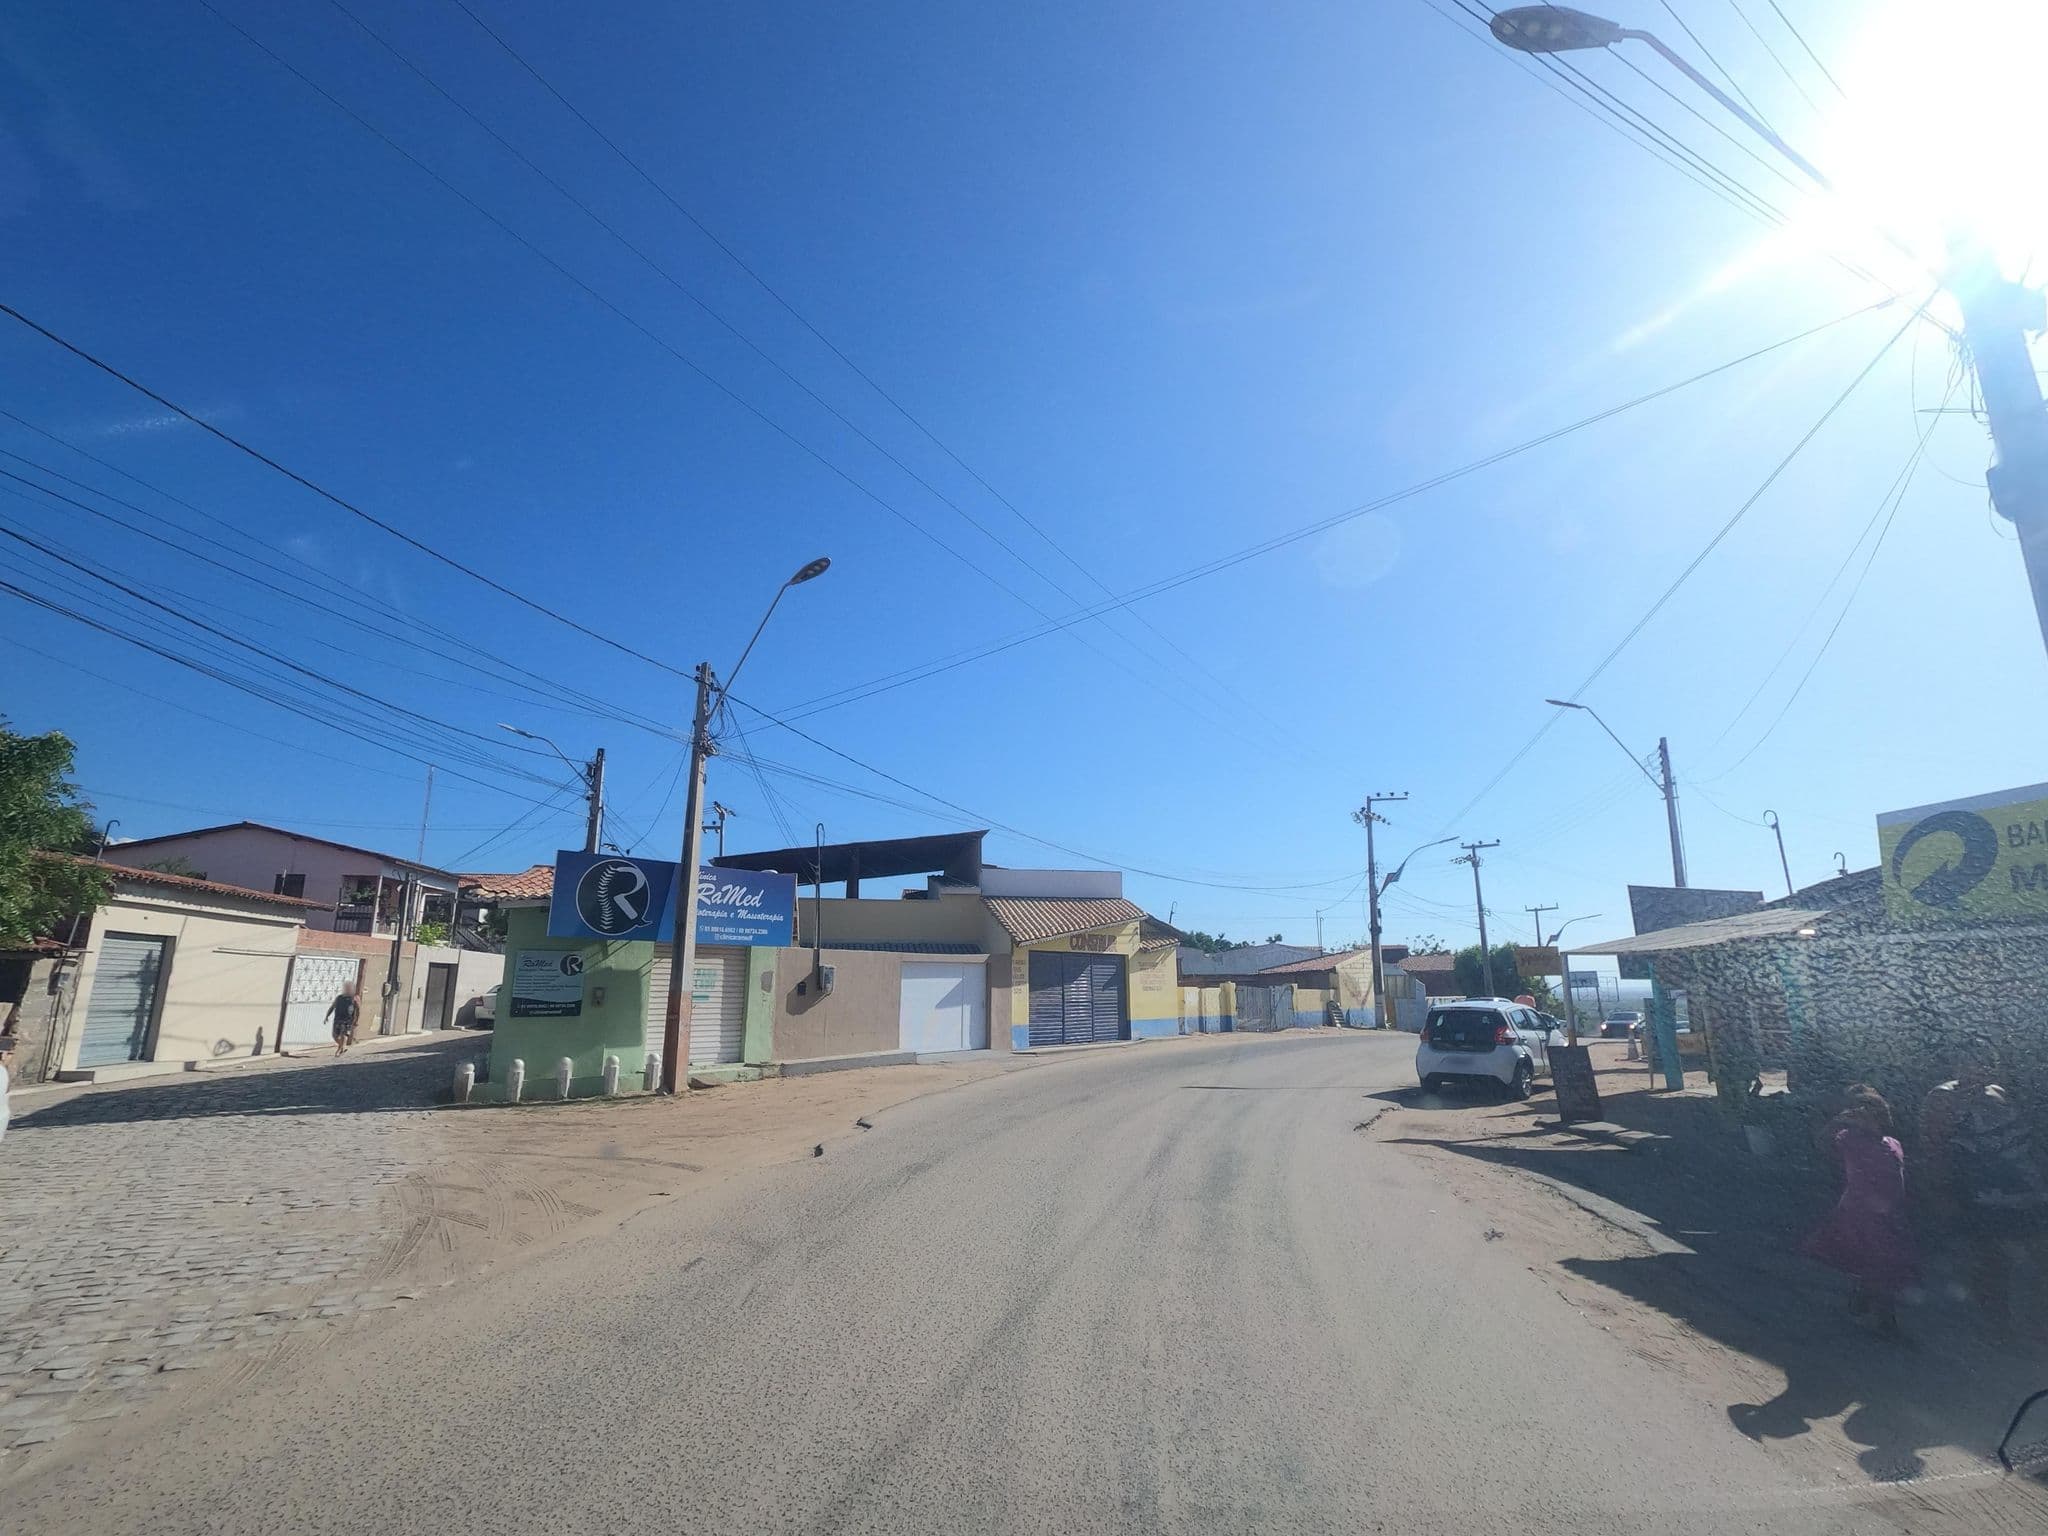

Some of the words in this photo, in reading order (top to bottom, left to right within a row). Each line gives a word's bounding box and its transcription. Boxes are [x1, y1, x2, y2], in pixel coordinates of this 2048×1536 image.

[2007, 820, 2048, 848] BA
[697, 882, 764, 908] RaMed
[697, 909, 728, 919] oterapia
[737, 909, 784, 922] Massoterapia
